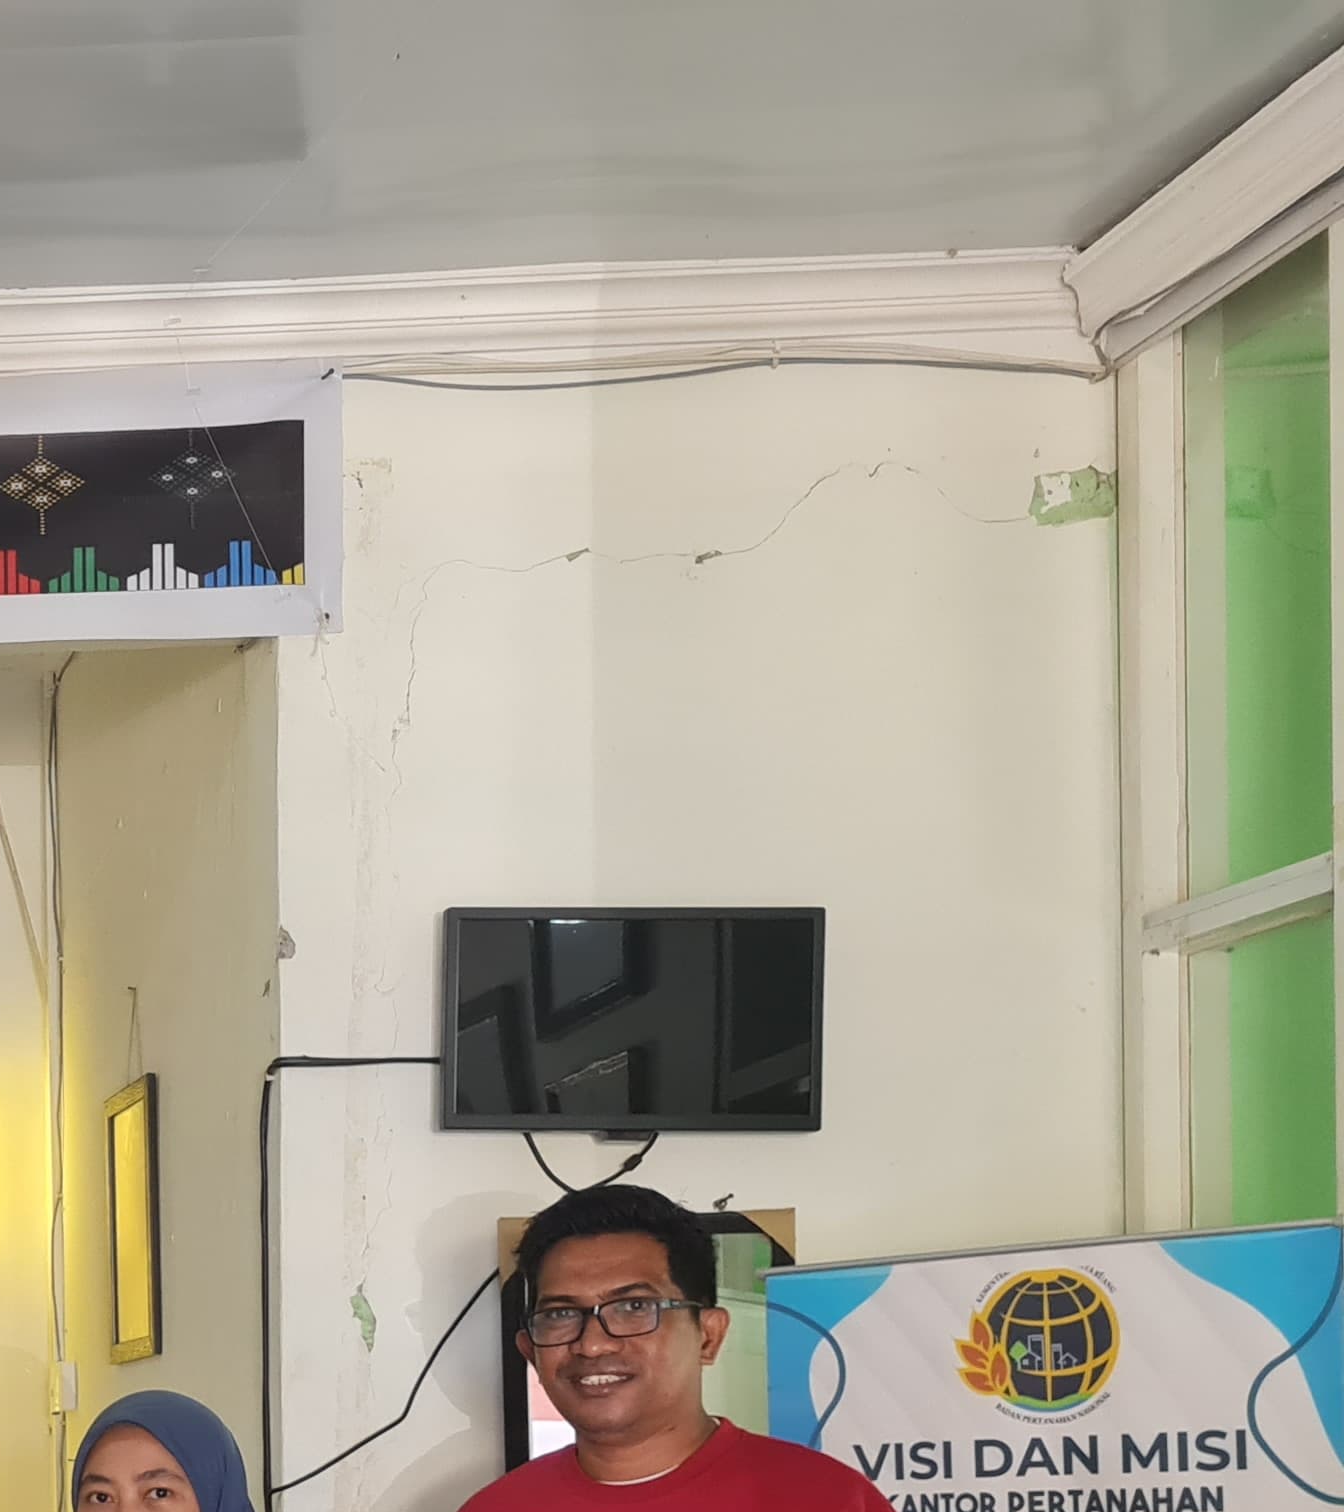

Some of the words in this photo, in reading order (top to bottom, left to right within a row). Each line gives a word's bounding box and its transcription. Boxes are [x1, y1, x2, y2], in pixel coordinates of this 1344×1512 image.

[853, 1440, 952, 1481] VISI
[975, 1435, 1099, 1479] DAN
[1122, 1429, 1249, 1474] MISI
